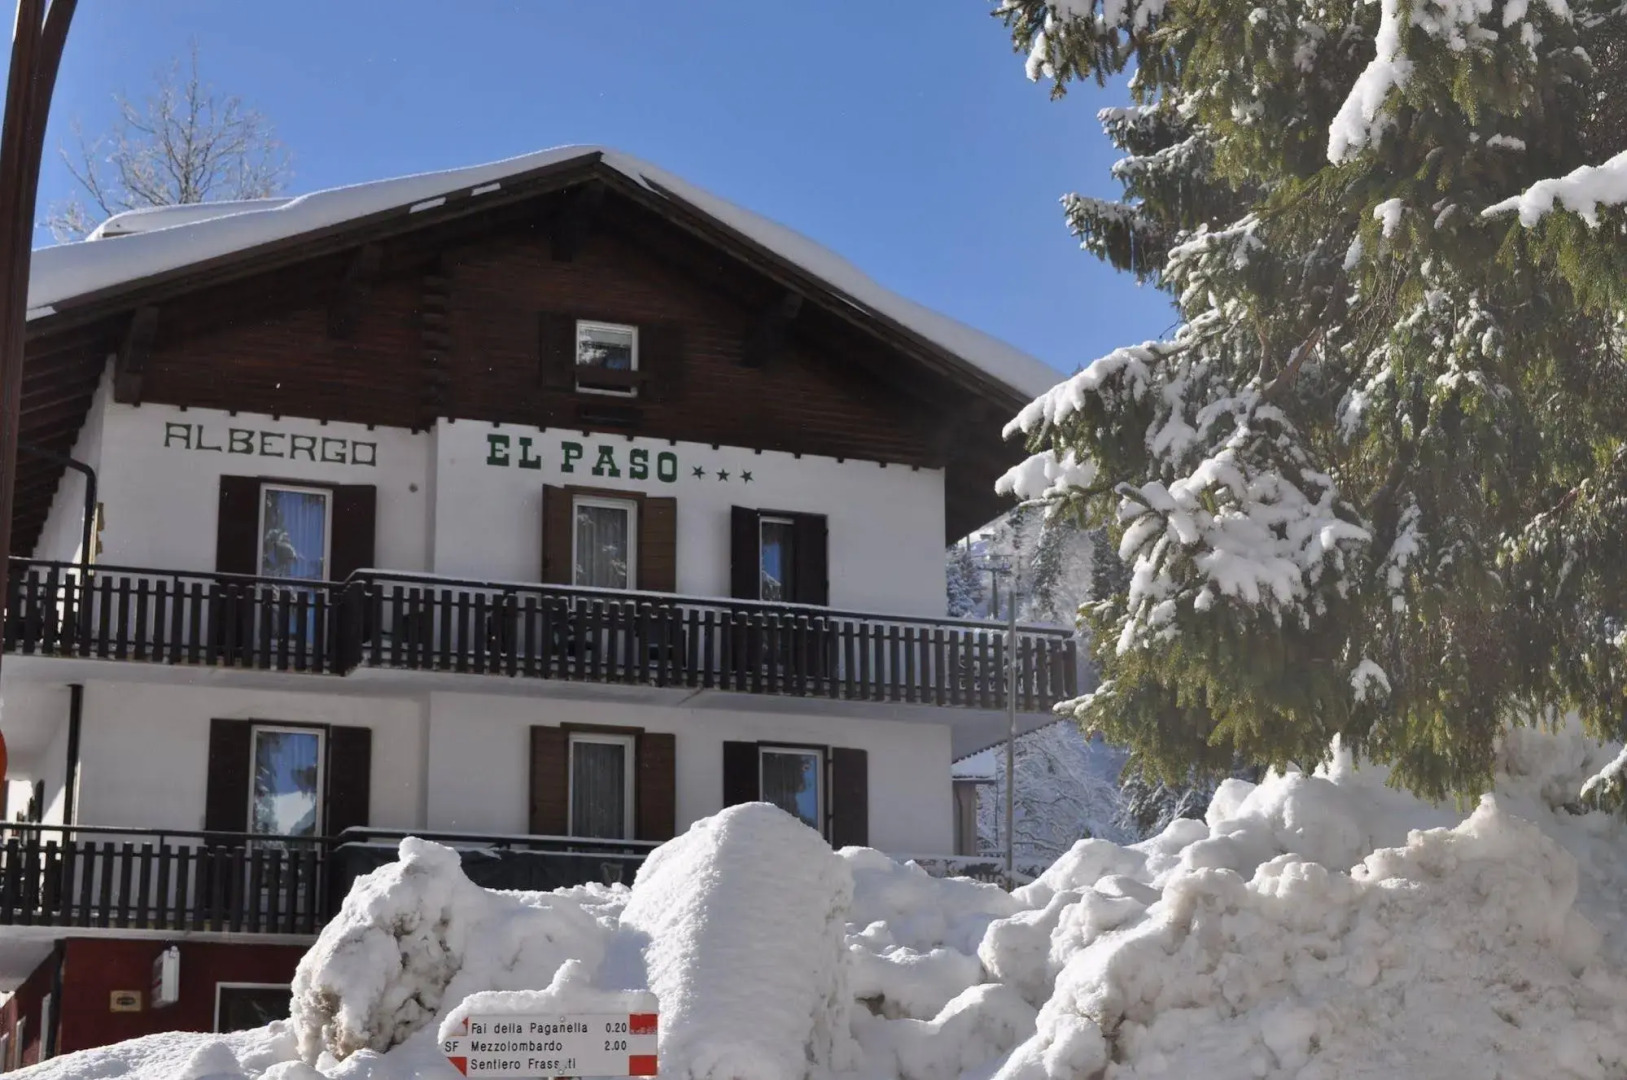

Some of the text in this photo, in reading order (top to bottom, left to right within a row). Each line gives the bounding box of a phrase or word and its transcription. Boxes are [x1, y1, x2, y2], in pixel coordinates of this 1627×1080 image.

[163, 421, 377, 467] ALBERGO
[486, 433, 678, 483] EL PASO
[471, 1022, 627, 1036] Fai della Paganella 0.20
[444, 1041, 459, 1053] SF
[471, 1040, 627, 1052] Mezzolombardo 2.00
[470, 1057, 576, 1070] Sentiero Frassti
